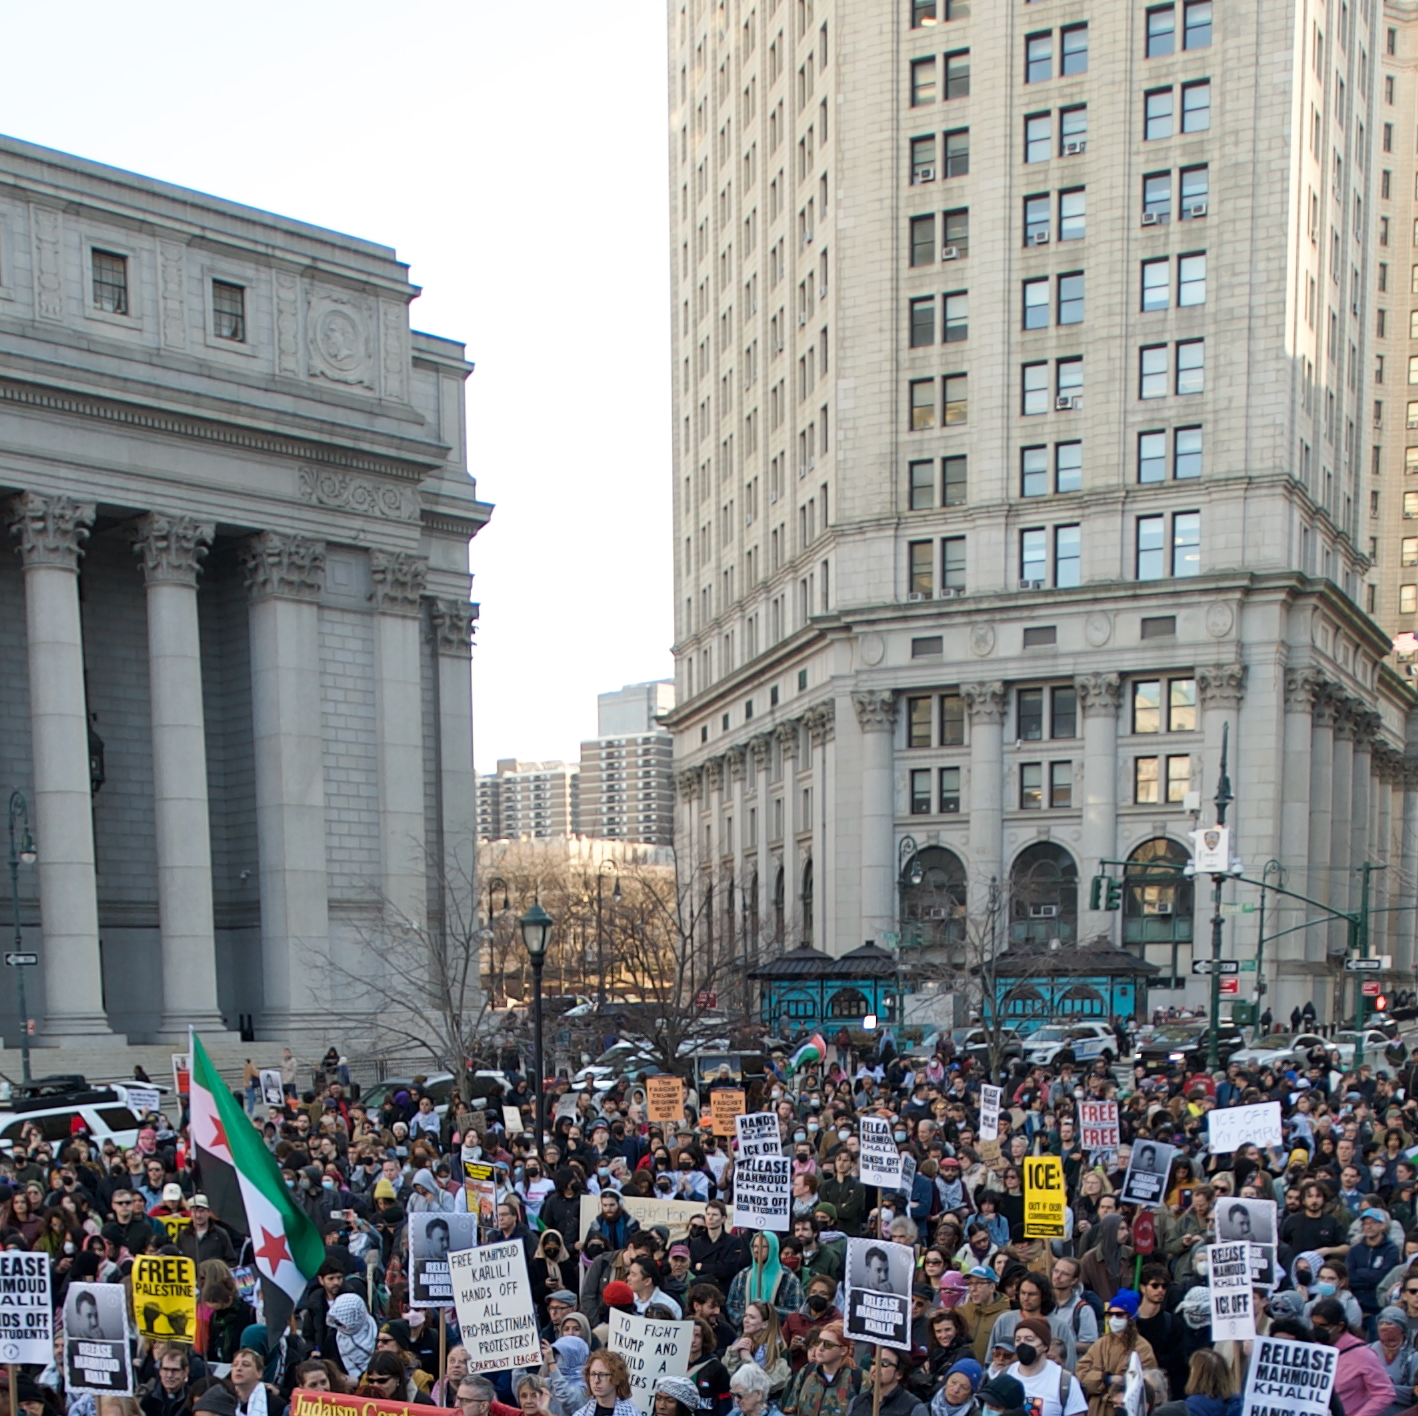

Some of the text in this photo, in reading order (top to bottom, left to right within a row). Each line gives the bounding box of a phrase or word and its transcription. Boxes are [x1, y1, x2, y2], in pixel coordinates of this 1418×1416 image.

[1082, 1104, 1116, 1122] FREE
[1215, 1109, 1270, 1126] ICE OFF
[740, 1116, 775, 1129] HANDS
[1082, 1128, 1117, 1145] FREE
[744, 1143, 778, 1155] ICE OFF
[737, 1158, 788, 1173] RELEASE
[737, 1172, 788, 1184] MAHMOUD
[1029, 1164, 1061, 1190] ICE:
[736, 1184, 788, 1193] KHALIL
[737, 1194, 788, 1206] HANDS OFF
[451, 1252, 473, 1269] FREE
[138, 1259, 190, 1283] FREE
[135, 1283, 193, 1298] PALESTINE
[462, 1281, 518, 1302] HANDS OFF
[483, 1303, 501, 1317] ALL
[26, 1313, 49, 1327] OFF
[619, 1317, 680, 1339] TO FIGHT
[655, 1343, 677, 1356] AND
[1260, 1342, 1335, 1373] RELEASE
[658, 1363, 666, 1373] A
[1256, 1364, 1330, 1390] MAHMOUD
[1253, 1382, 1326, 1404] KHALIL
